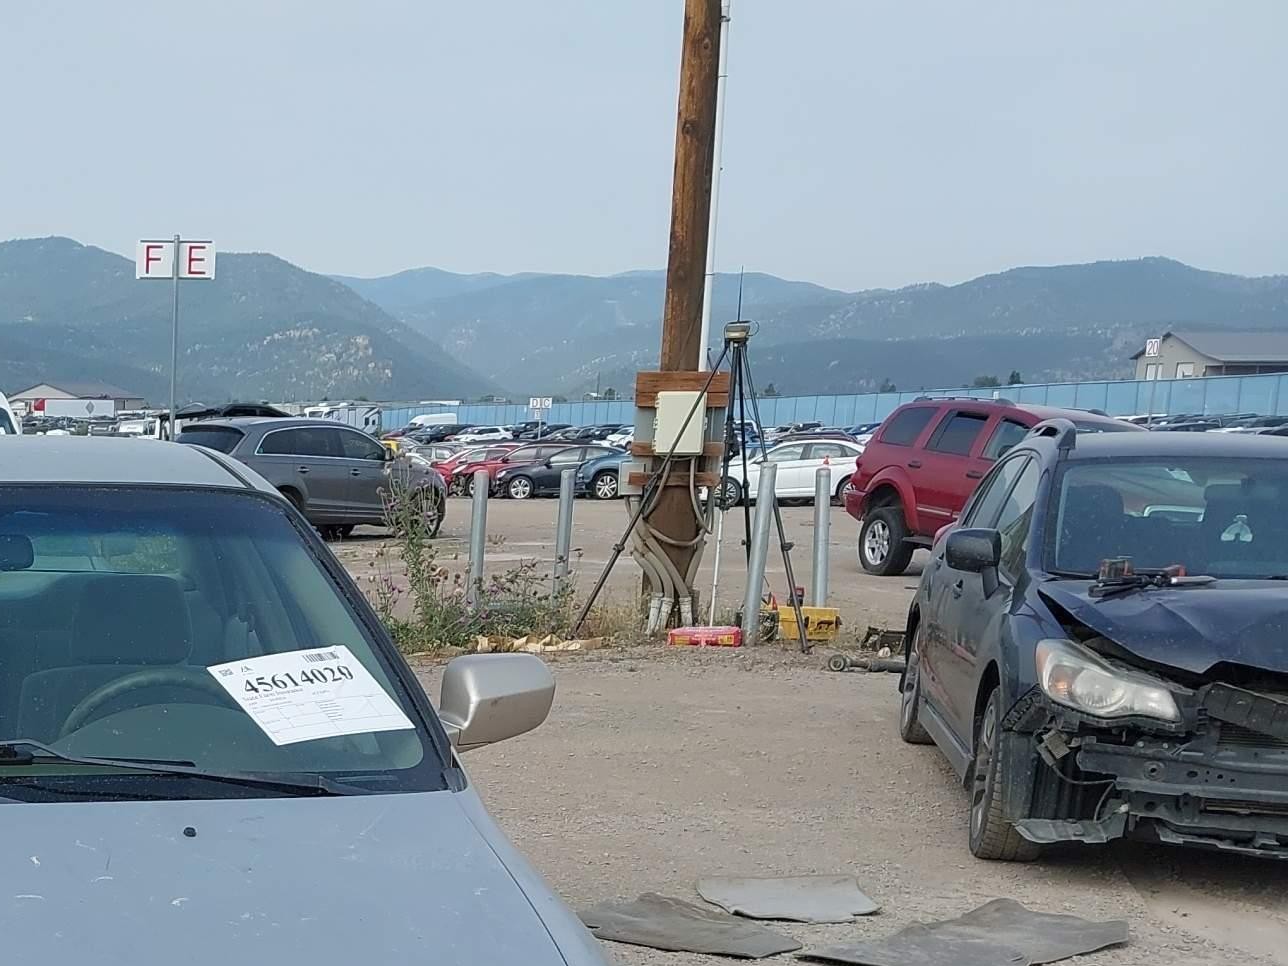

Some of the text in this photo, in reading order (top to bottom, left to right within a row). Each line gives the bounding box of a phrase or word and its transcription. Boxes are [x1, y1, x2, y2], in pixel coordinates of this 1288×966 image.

[145, 245, 163, 274] F
[188, 246, 206, 275] E
[1147, 340, 1159, 355] 20
[532, 399, 539, 407] D
[543, 399, 550, 407] C
[244, 665, 354, 694] 45614020
